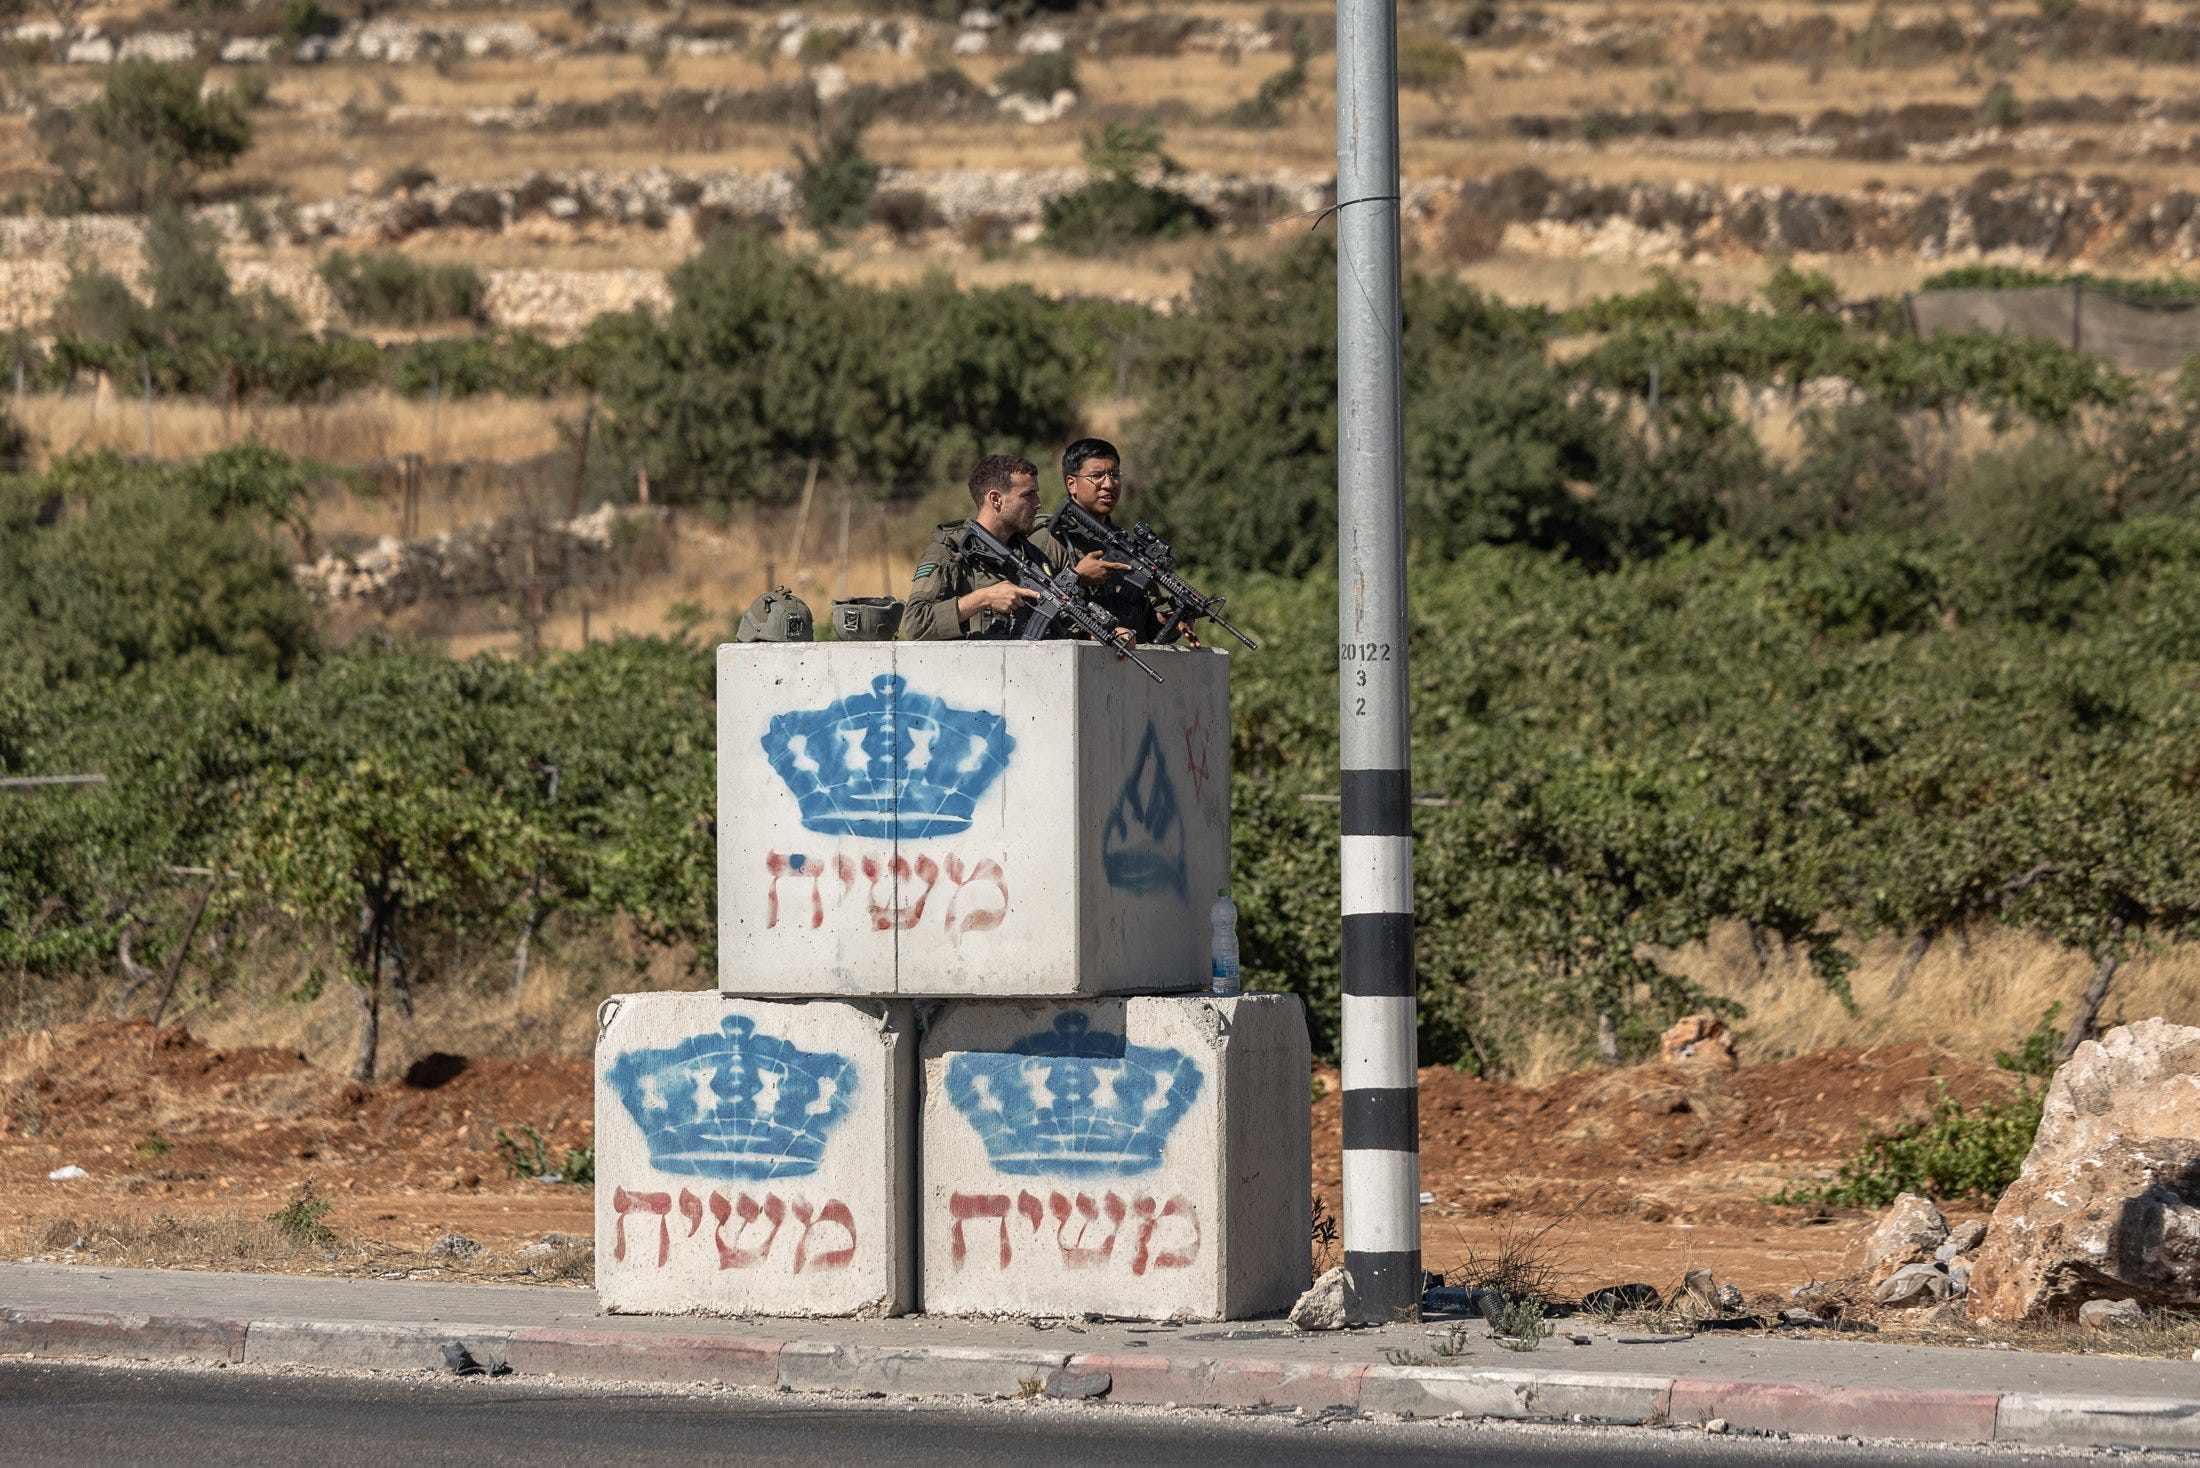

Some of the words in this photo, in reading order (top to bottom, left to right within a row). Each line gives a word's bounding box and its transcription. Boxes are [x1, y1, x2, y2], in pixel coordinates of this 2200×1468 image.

[1341, 643, 1391, 661] 20122
[1356, 670, 1367, 687] 3
[1355, 697, 1366, 716] 2
[766, 849, 1008, 932] משיח
[613, 1185, 857, 1275] משיח
[950, 1189, 1201, 1276] משיח
